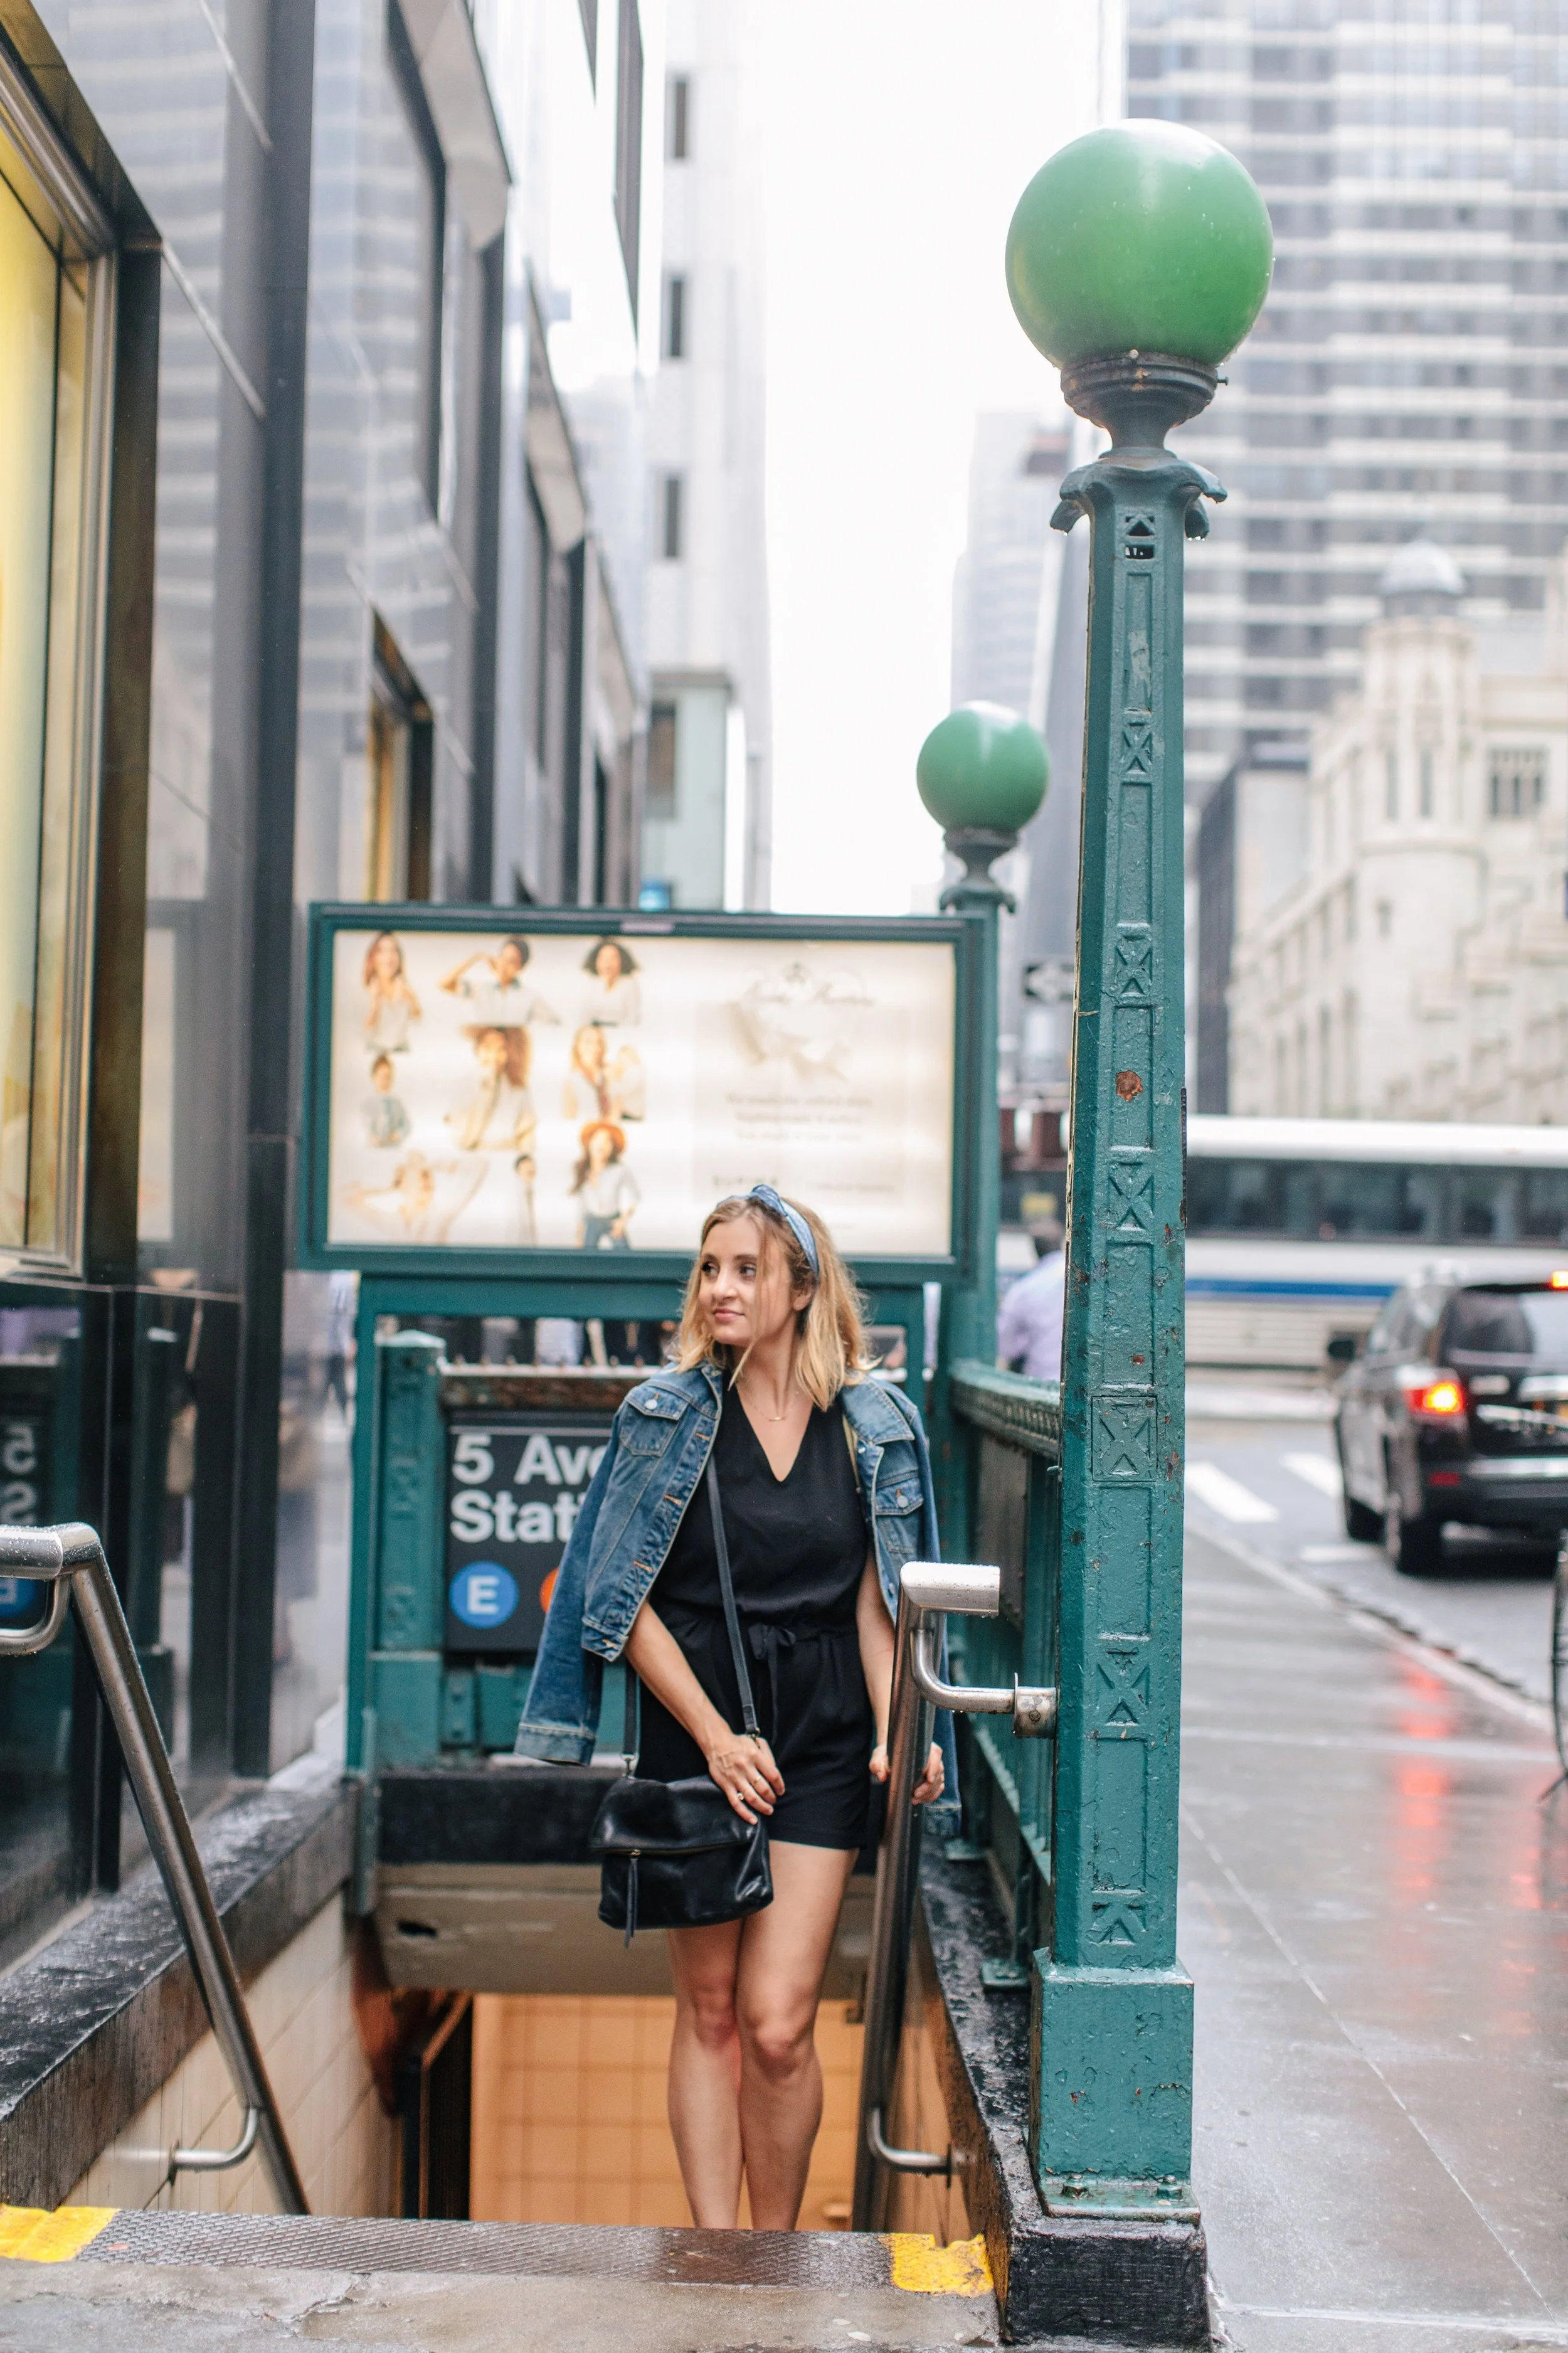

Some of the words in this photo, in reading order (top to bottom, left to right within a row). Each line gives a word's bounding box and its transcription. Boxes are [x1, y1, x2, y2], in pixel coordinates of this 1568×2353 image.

[452, 1433, 495, 1485] 5
[450, 1489, 587, 1543] Stat
[467, 1575, 501, 1615] E
